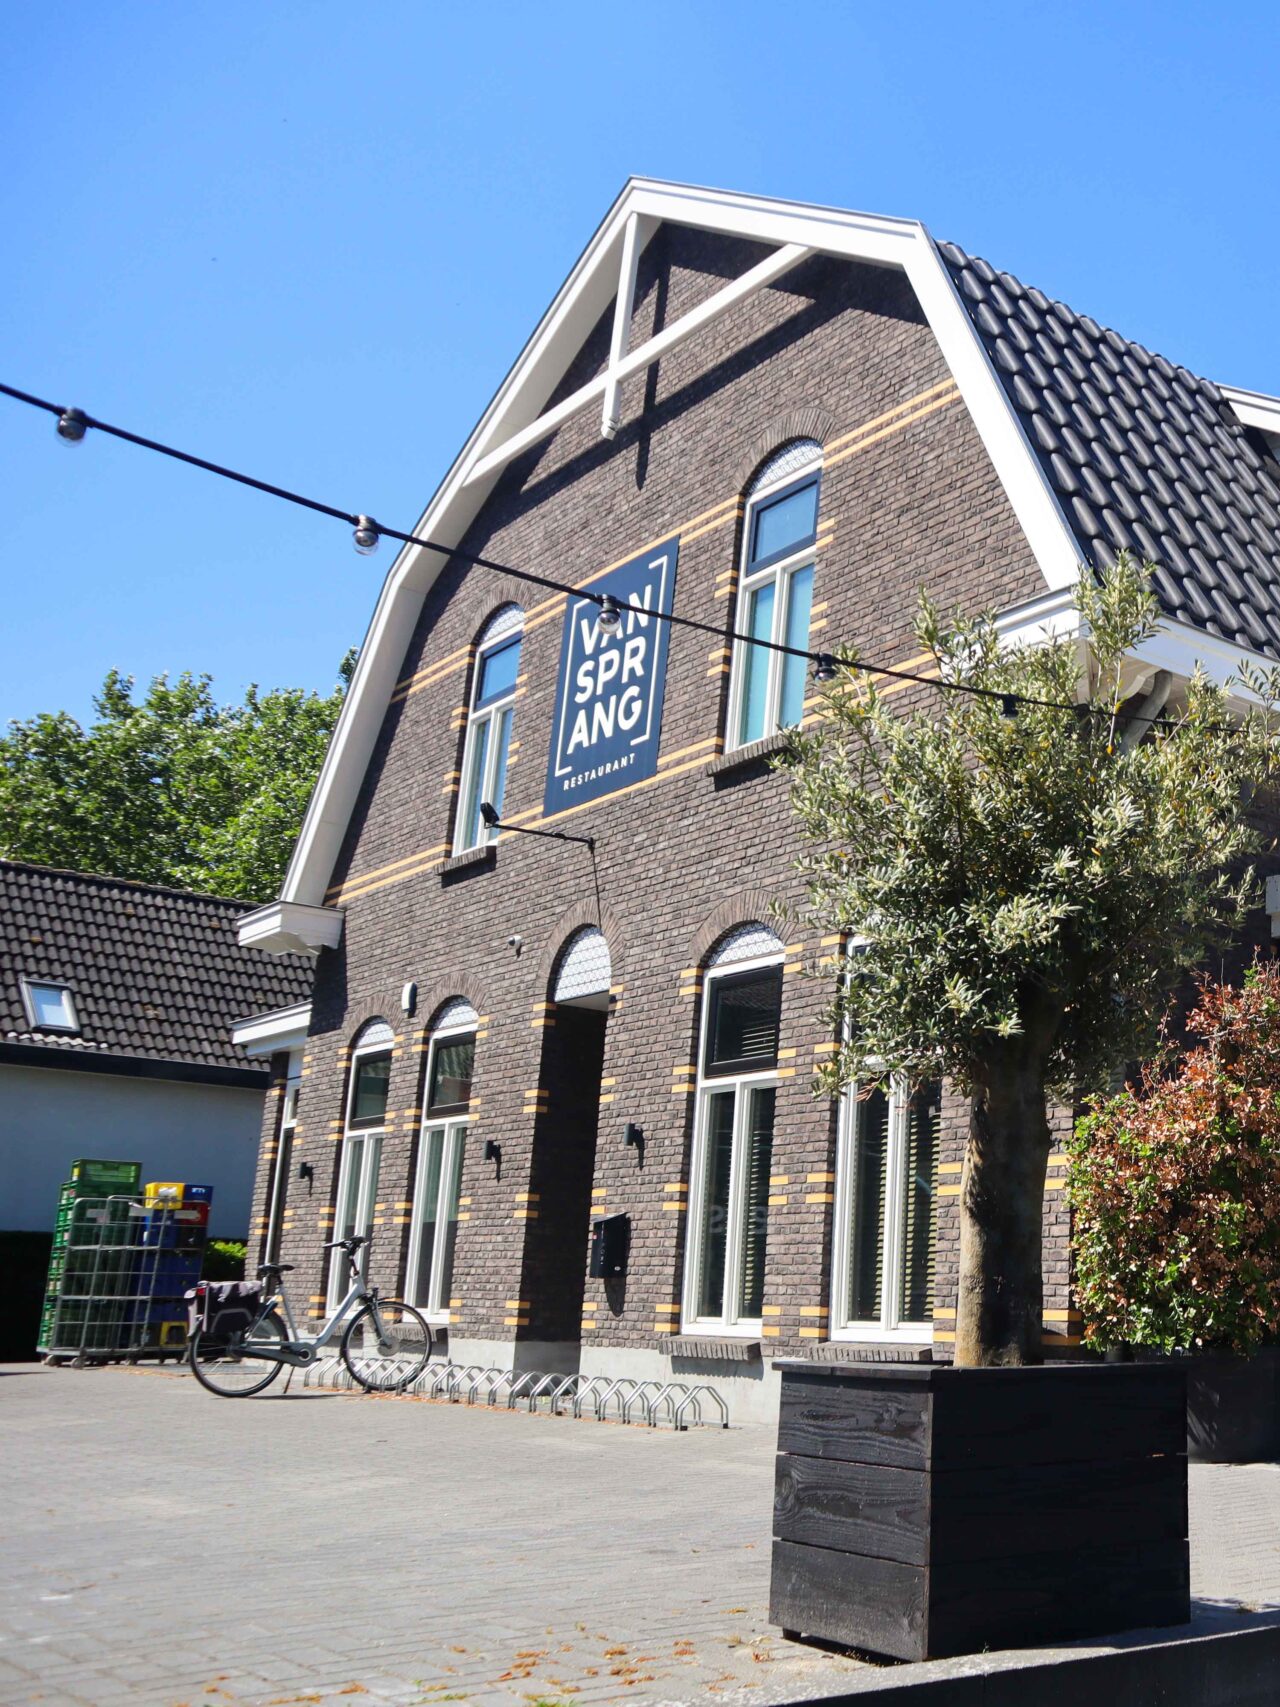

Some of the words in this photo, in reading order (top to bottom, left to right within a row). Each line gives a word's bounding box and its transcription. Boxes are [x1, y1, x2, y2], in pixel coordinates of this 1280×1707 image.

[574, 636, 646, 703] SPR
[566, 685, 642, 755] ANG
[563, 752, 635, 791] RESTAURANT
